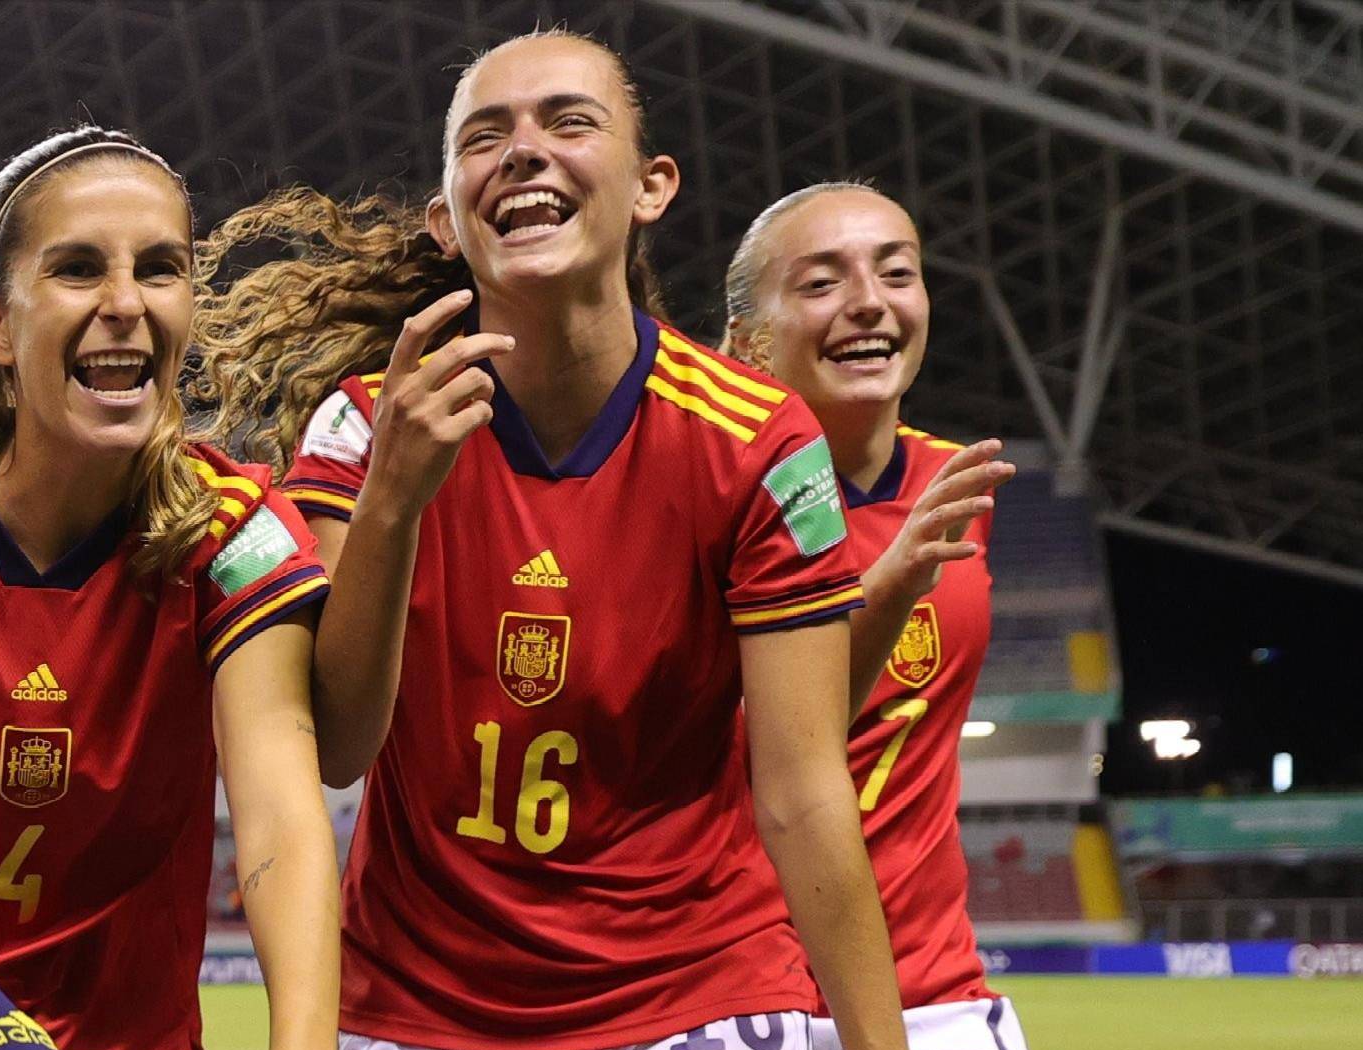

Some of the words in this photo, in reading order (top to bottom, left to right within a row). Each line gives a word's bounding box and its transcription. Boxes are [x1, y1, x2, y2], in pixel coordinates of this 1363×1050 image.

[512, 571, 569, 588] adidas
[11, 687, 68, 702] adidas
[859, 698, 929, 812] 7
[456, 720, 579, 854] 16
[1162, 943, 1233, 977] VISA
